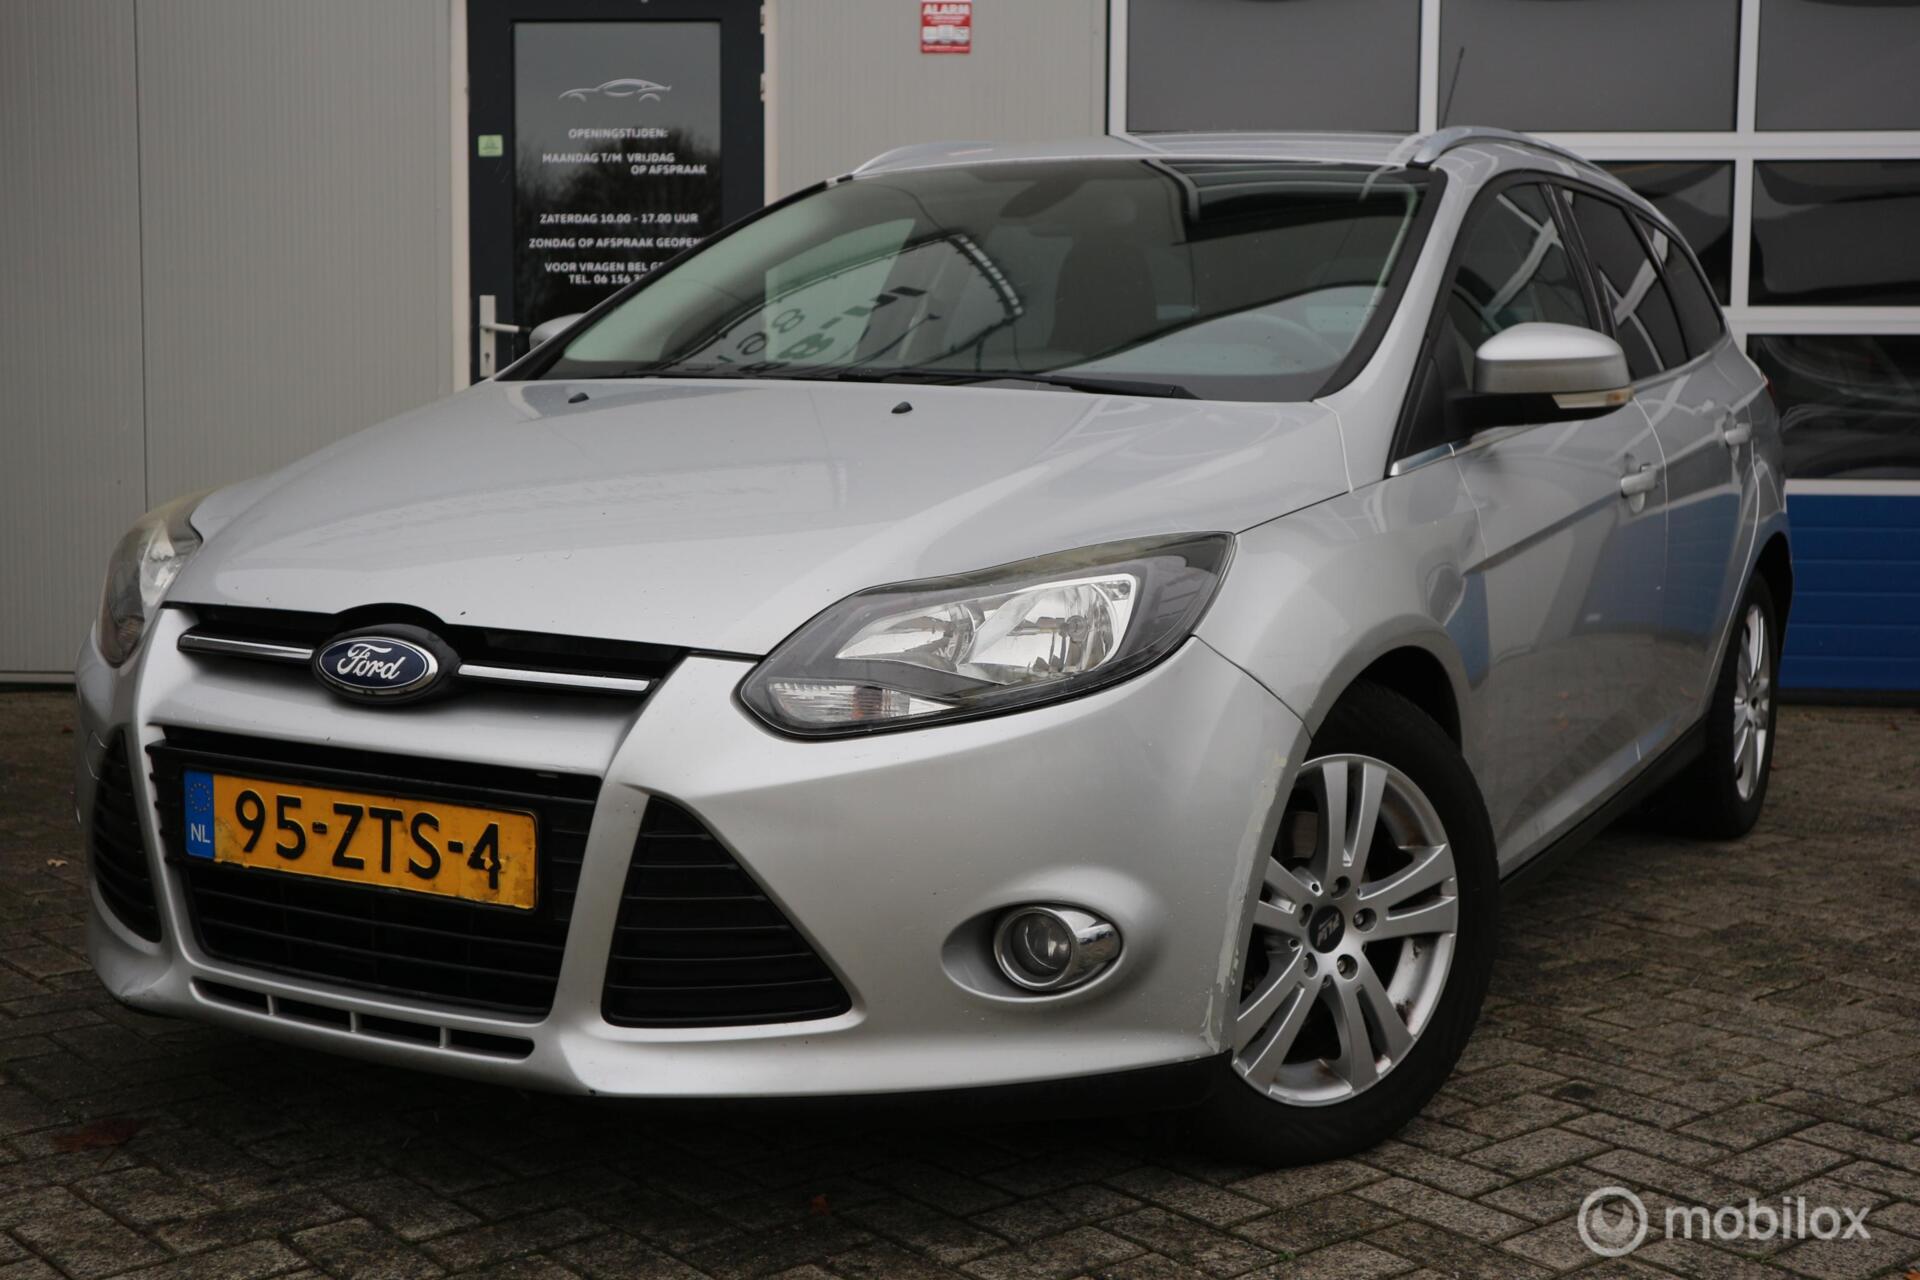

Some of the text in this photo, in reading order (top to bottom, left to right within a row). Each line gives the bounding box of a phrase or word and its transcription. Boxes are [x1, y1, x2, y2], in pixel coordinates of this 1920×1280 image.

[568, 128, 669, 139] OPENINGSTIJDEN:
[542, 153, 675, 164] MAANDAG T/M VRIJDAG
[630, 164, 707, 175] OP AFSPRAAK
[539, 213, 598, 224] ZATERDAG
[600, 213, 631, 224] 10.00
[641, 213, 672, 224] 17.00
[674, 213, 699, 224] UUR
[528, 237, 575, 249] ZONDAG
[578, 237, 594, 249] OP
[596, 237, 654, 249] AFSPRAAK
[544, 262, 577, 273] VOOR
[579, 262, 625, 273] VRAGEN
[627, 262, 648, 273] BEL
[569, 274, 591, 285] TEL.
[593, 274, 608, 285] 06
[611, 274, 631, 285] 156
[336, 642, 405, 680] Ford
[190, 822, 212, 844] NL
[234, 788, 502, 890] 95-ZTS-4
